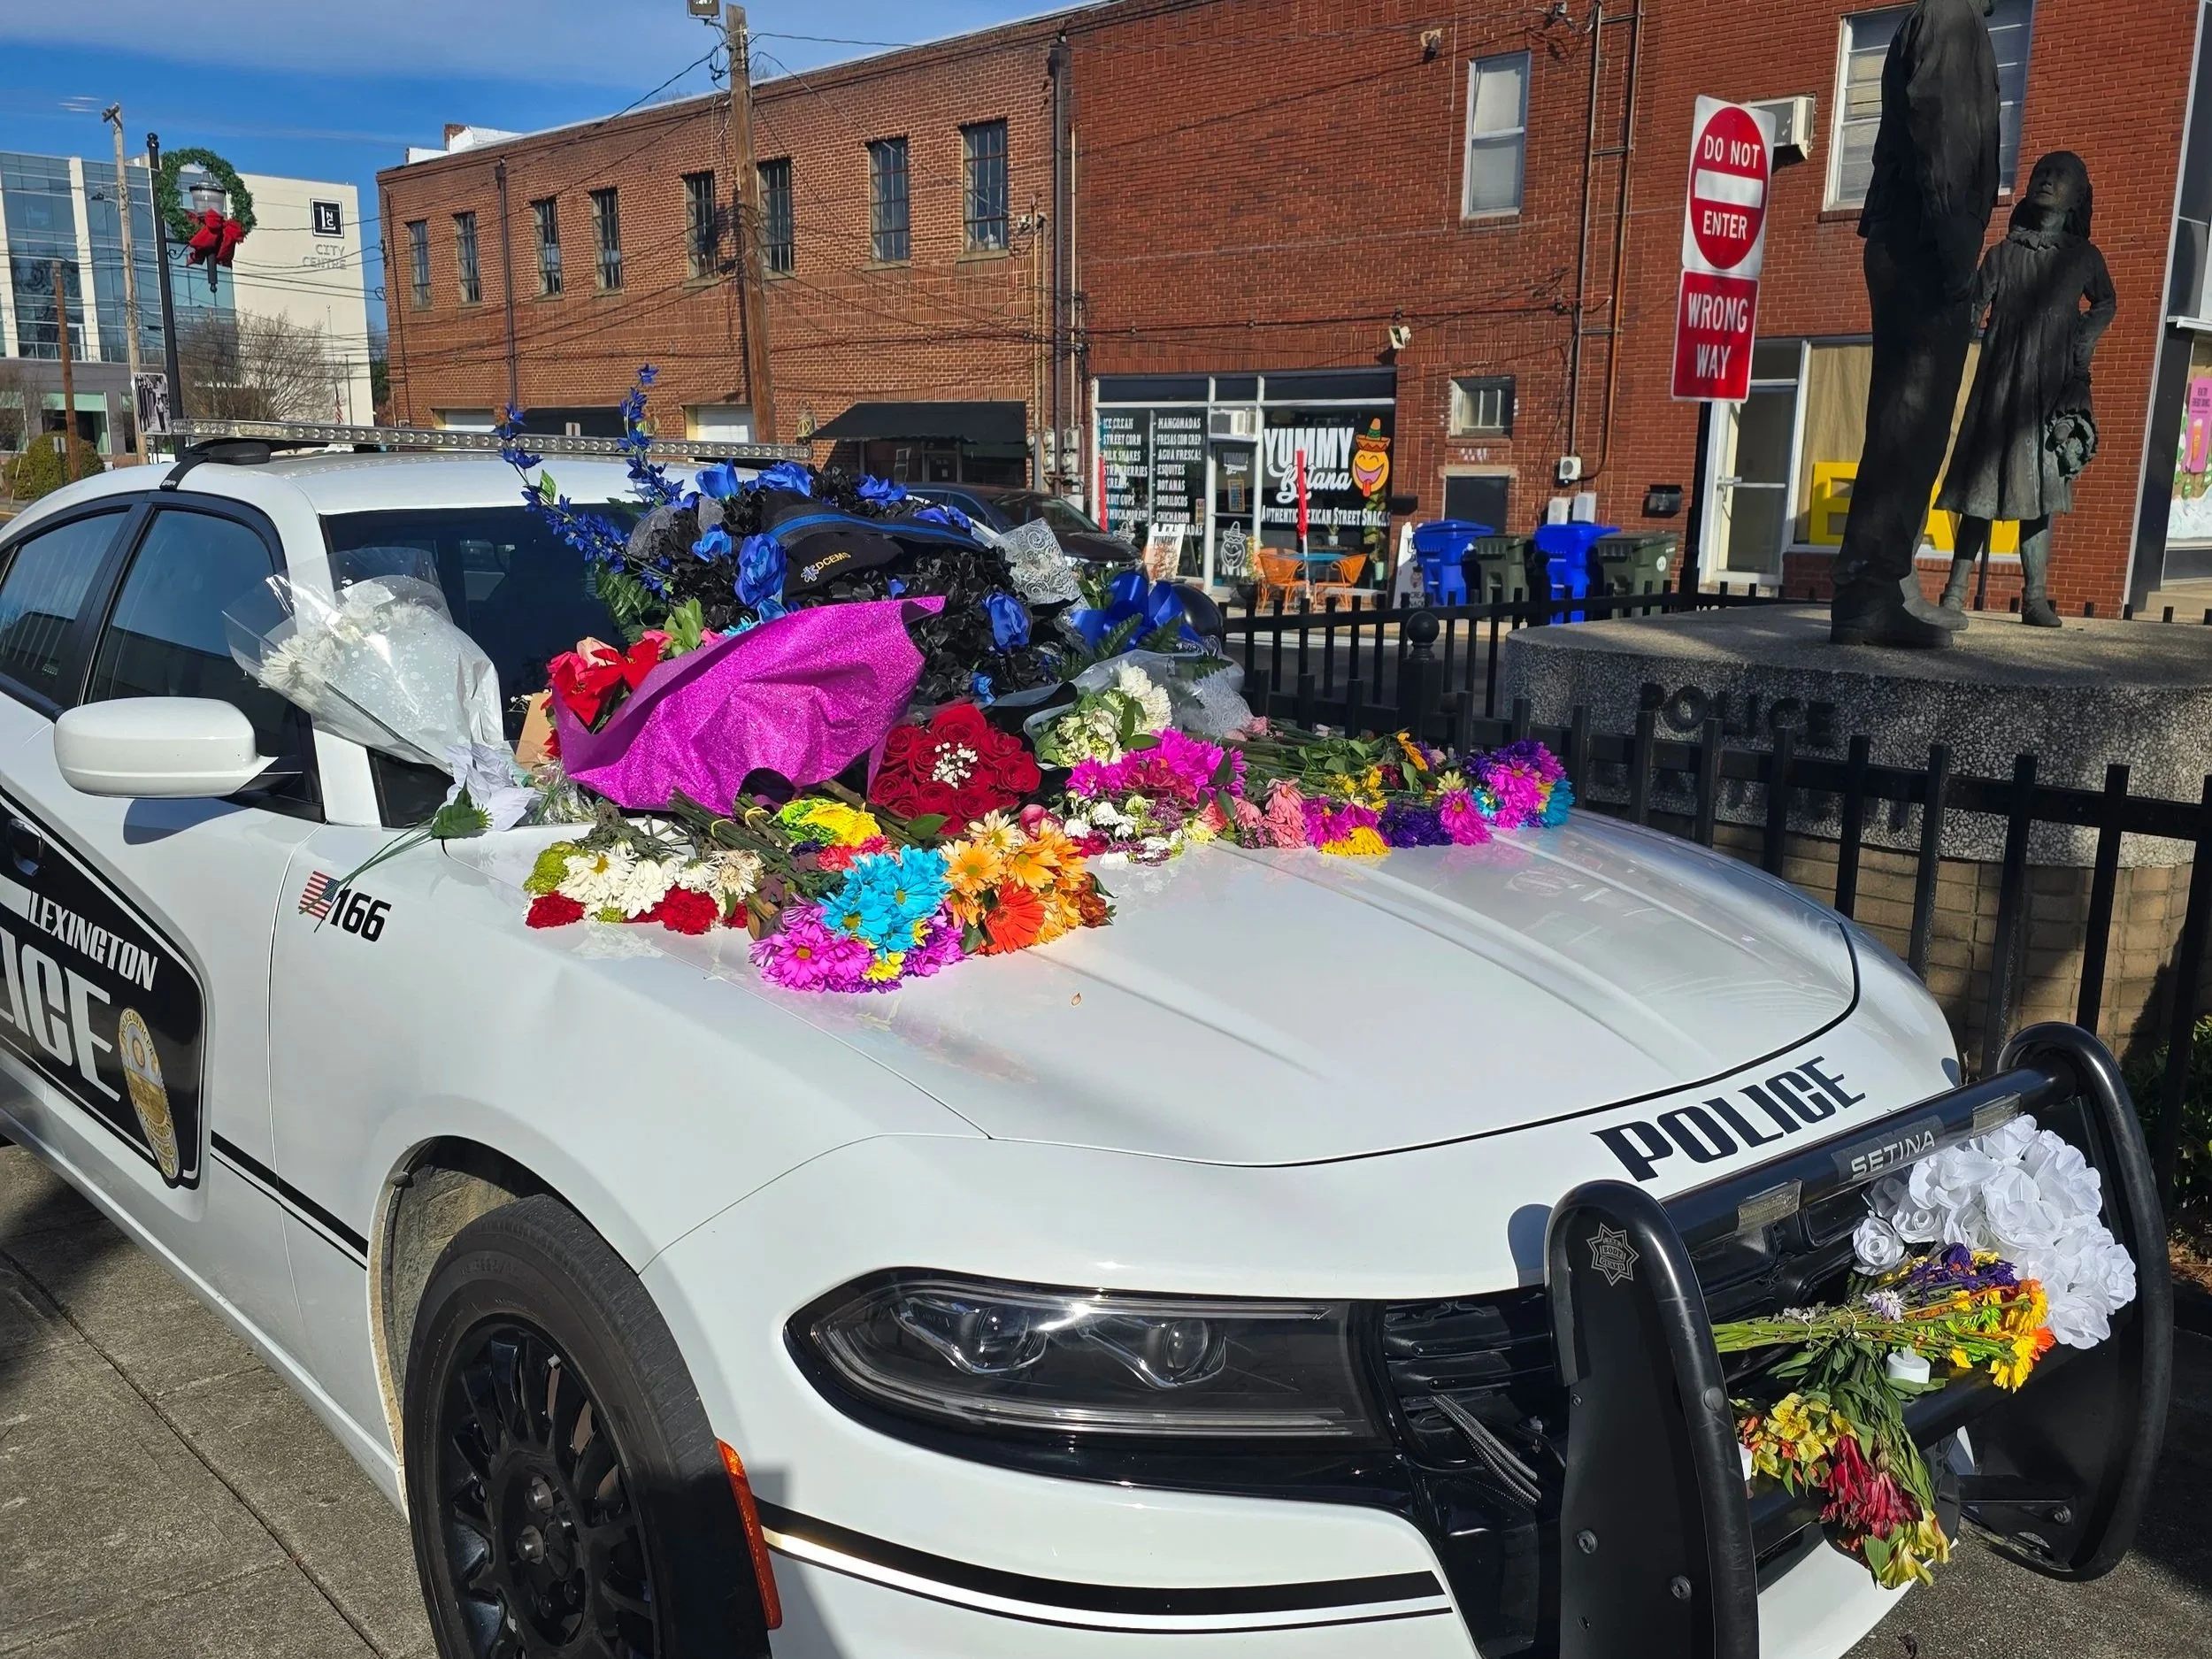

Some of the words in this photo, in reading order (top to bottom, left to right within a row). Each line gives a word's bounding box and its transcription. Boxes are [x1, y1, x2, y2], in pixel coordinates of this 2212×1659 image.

[1704, 134, 1724, 162] DO
[1730, 140, 1761, 169] NOT
[1702, 210, 1747, 241] ENTER
[315, 243, 345, 256] CITY
[302, 256, 347, 270] CENTRE
[1687, 292, 1748, 334] WRONG
[1696, 343, 1732, 380] WAY
[1102, 418, 1112, 429] ICE
[1113, 418, 1133, 429] CREAM
[1157, 417, 1202, 429] MANGONADAS
[1102, 434, 1125, 445] STREET
[1125, 434, 1141, 445] CORN
[1156, 434, 1177, 445] FRESAS
[1157, 449, 1175, 460] AGUA
[1263, 427, 1355, 469] YUMMY
[1118, 449, 1141, 461] SHAKES
[1156, 464, 1186, 476] ESQUITES
[1156, 480, 1186, 491] BOTANAS
[1268, 465, 1353, 503] Btana
[1105, 494, 1120, 505] RUIT
[1120, 494, 1135, 506] CUPS
[1156, 495, 1188, 506] DORILOCOS
[1110, 509, 1125, 520] MUCH
[1261, 505, 1299, 524] AUTHENTIC
[1306, 509, 1331, 525] EXICAN
[1333, 507, 1361, 526] STREET
[1640, 683, 1835, 747] POLICE
[330, 888, 392, 942] 166
[29, 891, 158, 992] LEXINGTON
[1590, 1056, 1866, 1182] POLICE
[1851, 1131, 1935, 1180] SETINA
[1603, 1247, 1624, 1258] BODY
